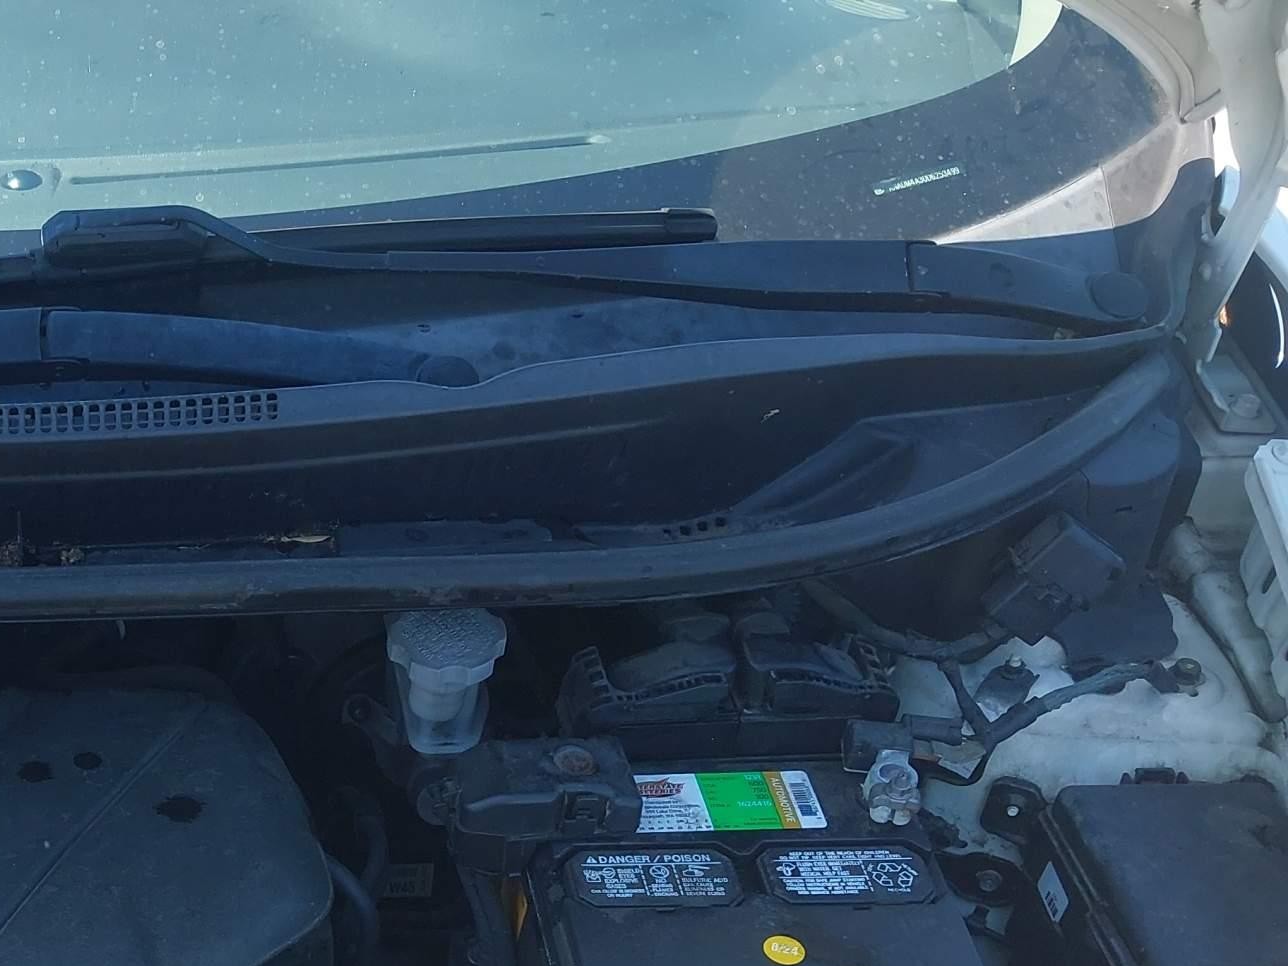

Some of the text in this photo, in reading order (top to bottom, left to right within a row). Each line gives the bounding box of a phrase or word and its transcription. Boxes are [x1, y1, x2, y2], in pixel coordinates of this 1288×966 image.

[770, 777, 797, 823] AUTOMOTIVE
[598, 854, 711, 864] DANGER / POISON
